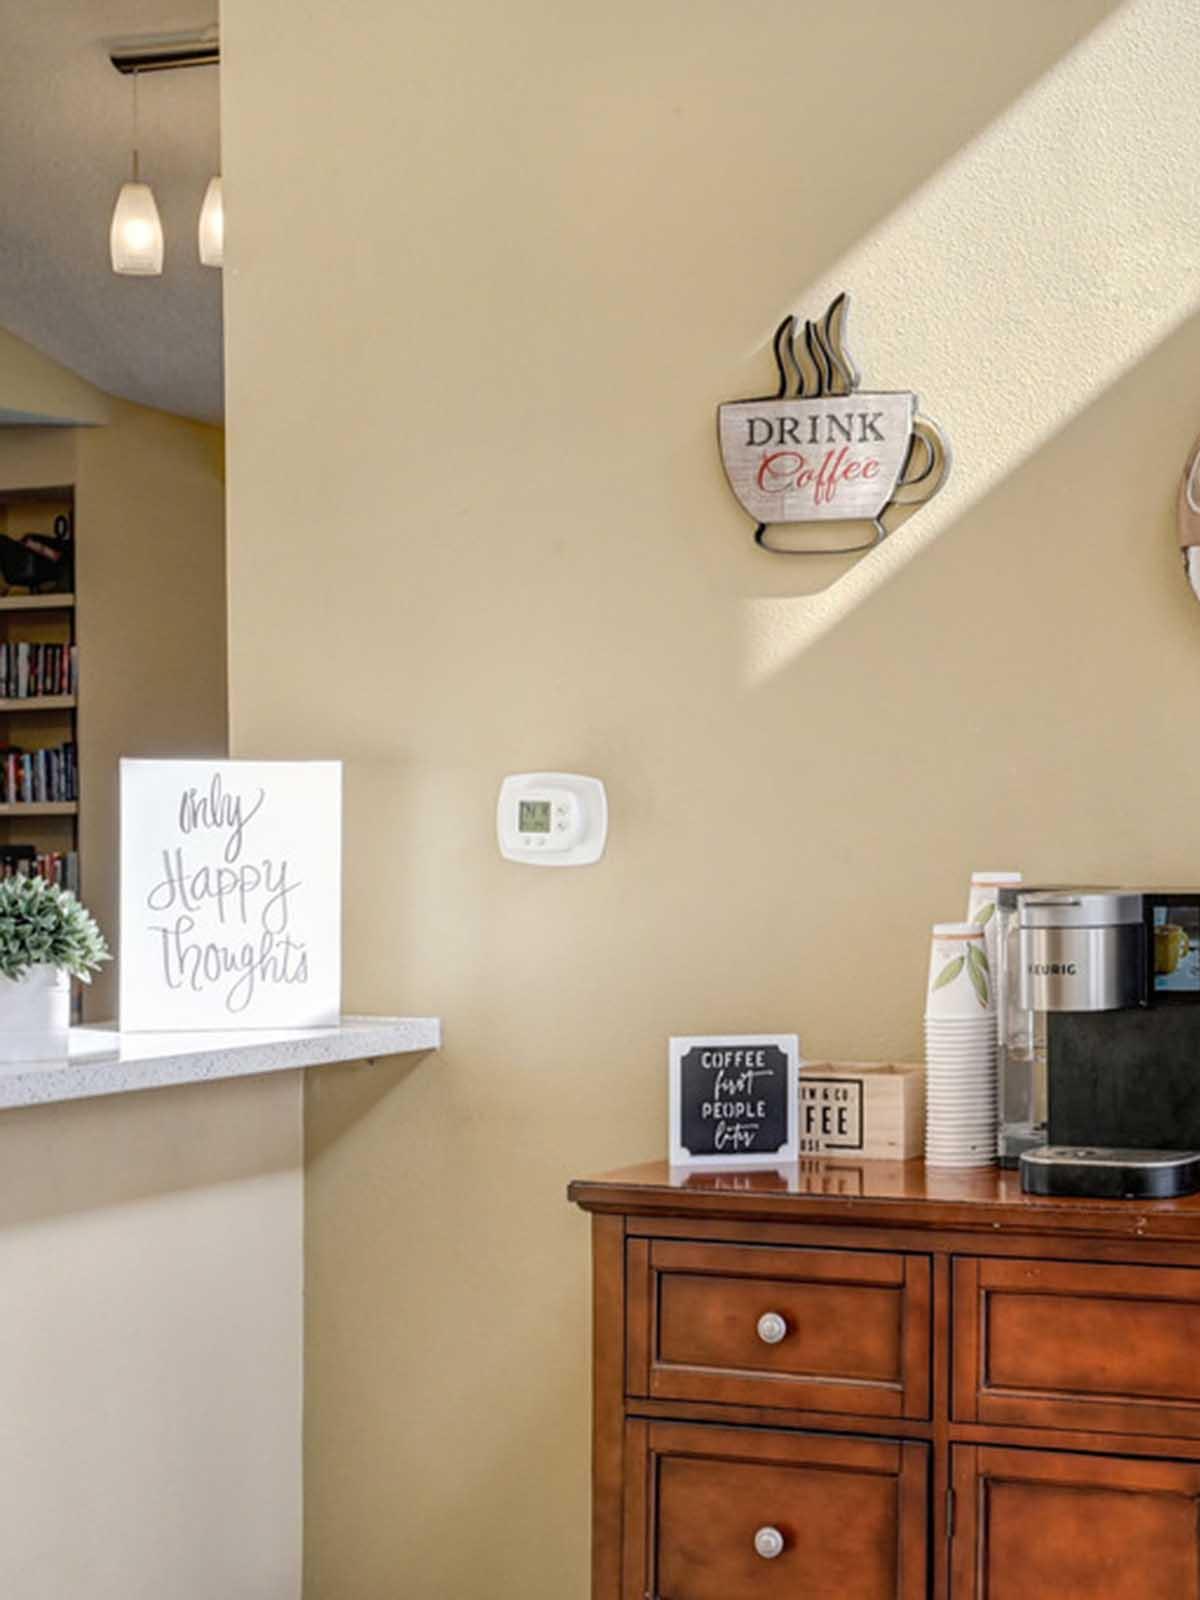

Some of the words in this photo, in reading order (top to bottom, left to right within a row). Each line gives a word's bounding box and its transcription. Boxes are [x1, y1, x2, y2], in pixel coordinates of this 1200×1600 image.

[745, 412, 885, 446] DRINK
[757, 446, 880, 505] Coffee
[147, 847, 303, 935] Happy
[147, 915, 309, 1013] Thoughts
[701, 1050, 766, 1068] COFFEE
[714, 1069, 774, 1101] first
[702, 1101, 766, 1119] PEOPLE
